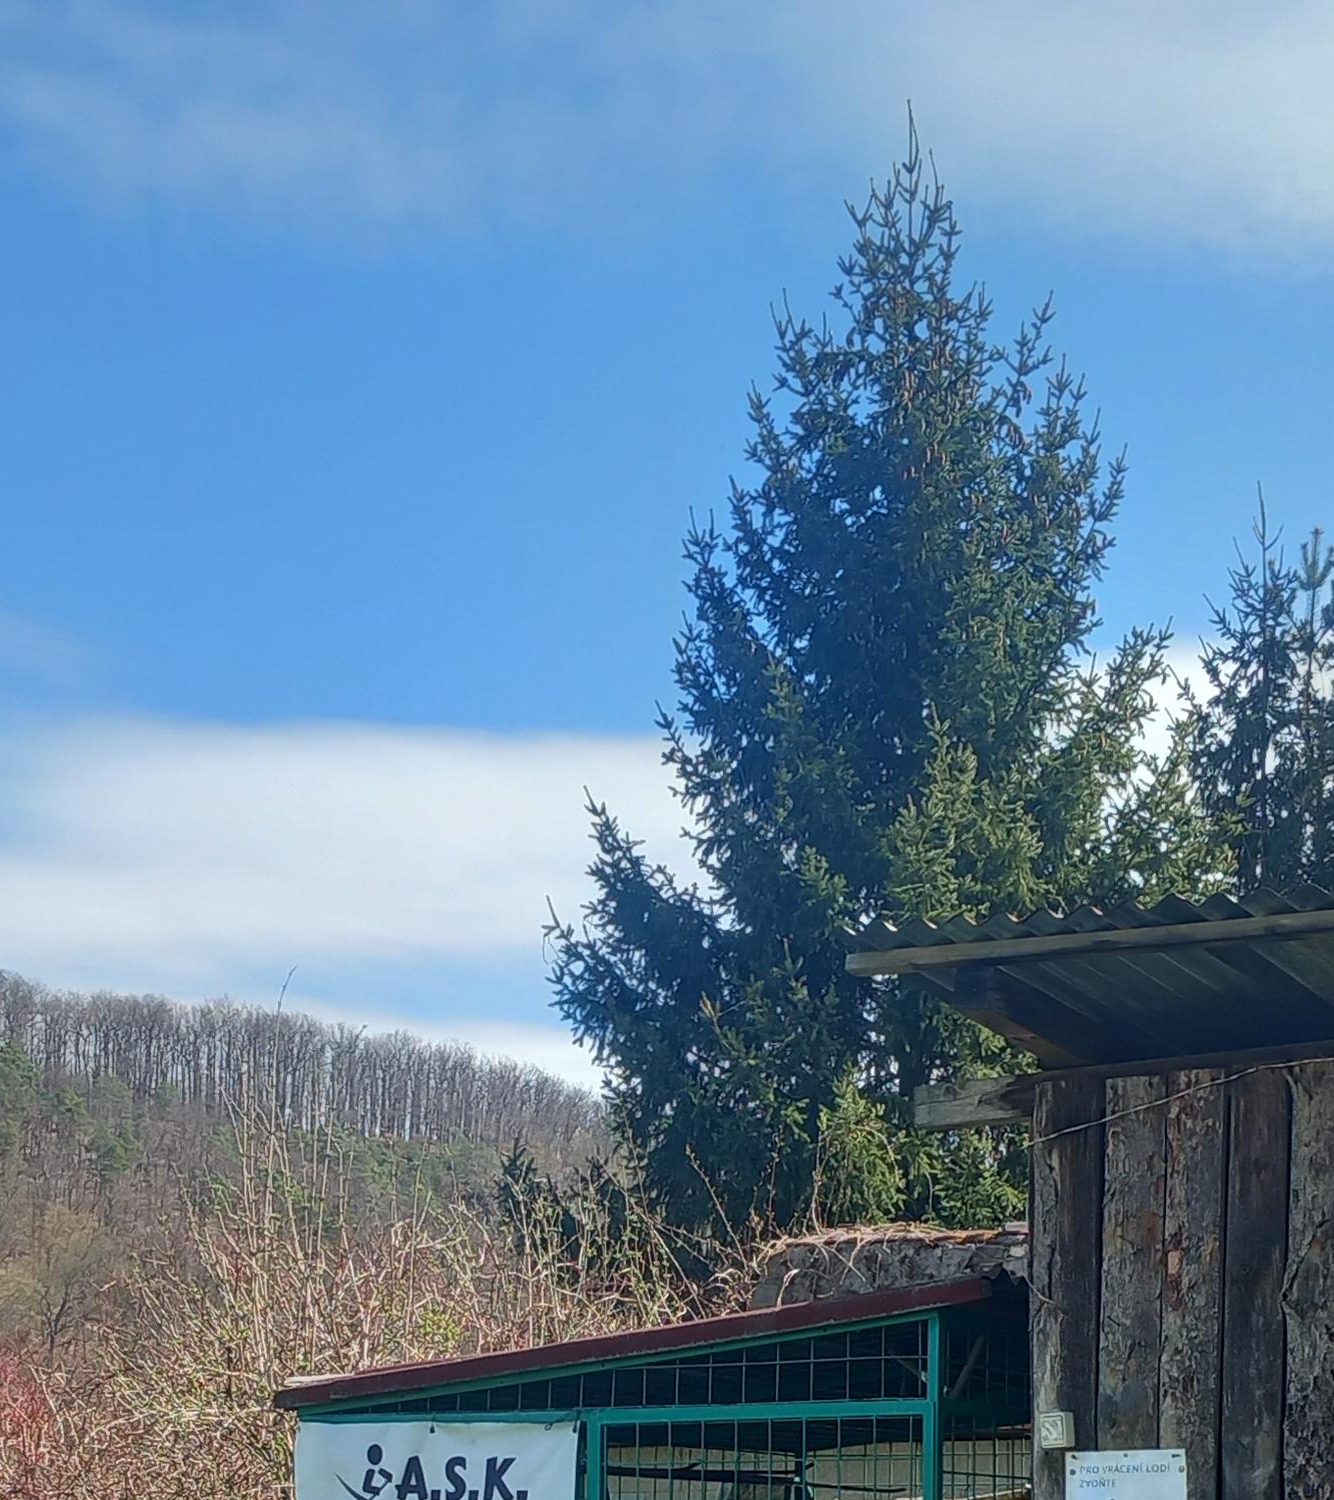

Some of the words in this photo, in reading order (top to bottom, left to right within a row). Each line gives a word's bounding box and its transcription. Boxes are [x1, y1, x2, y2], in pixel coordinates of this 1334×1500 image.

[1079, 1465, 1100, 1474] PRO
[1103, 1462, 1143, 1474] VRÁCENÍ
[1146, 1463, 1170, 1473] LODÍ
